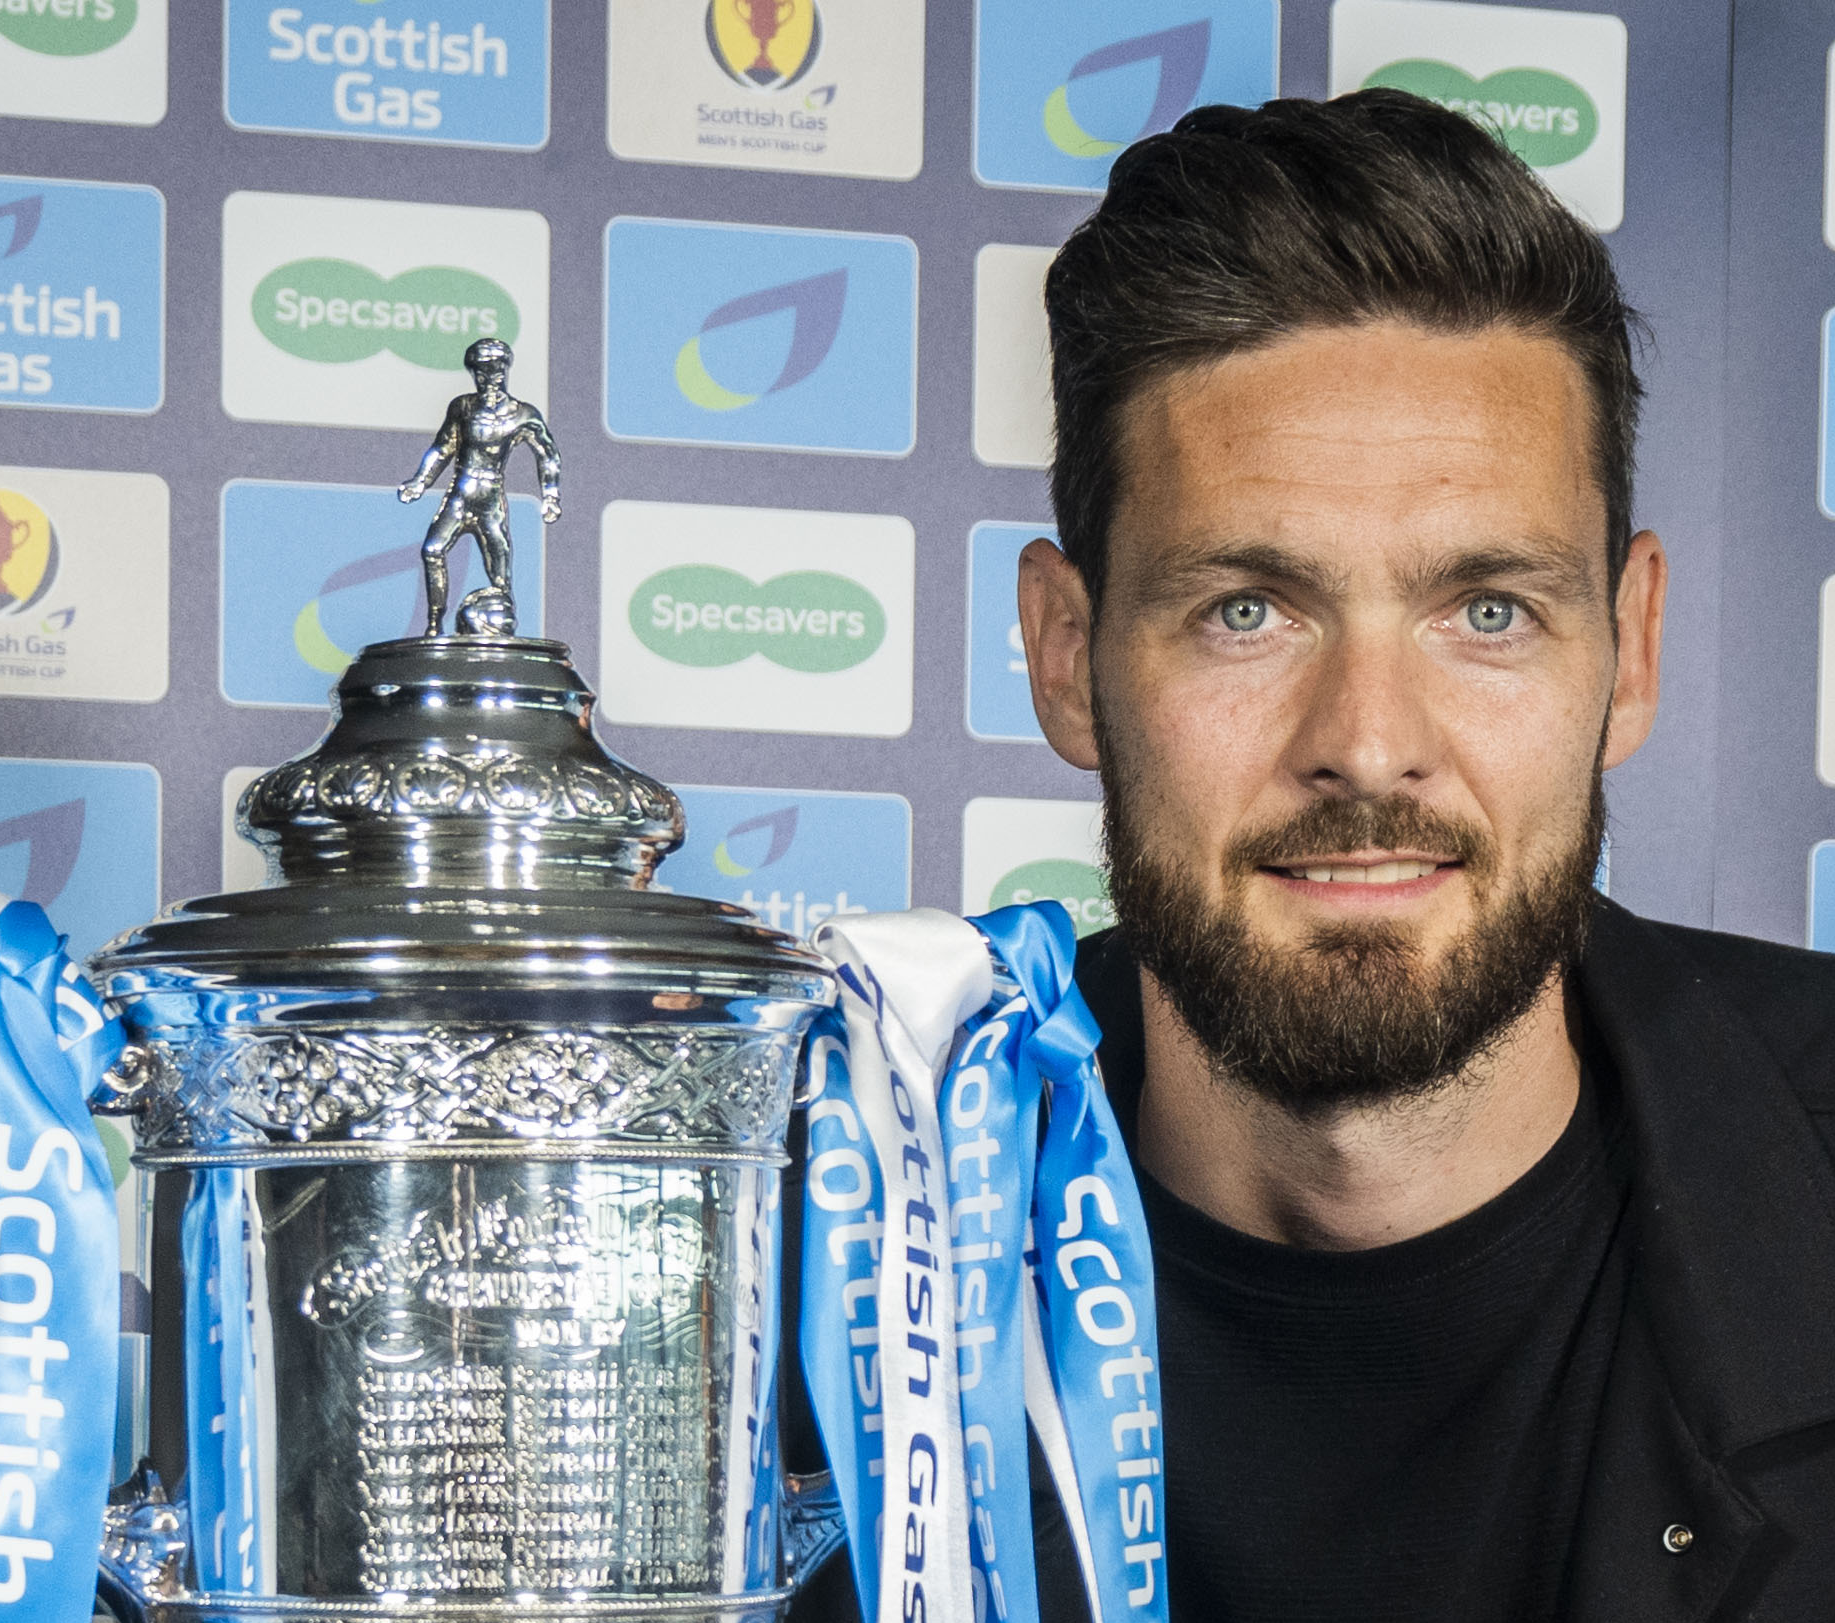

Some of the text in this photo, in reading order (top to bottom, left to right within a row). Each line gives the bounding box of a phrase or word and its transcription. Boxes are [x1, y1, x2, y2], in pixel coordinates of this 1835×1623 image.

[267, 7, 509, 79] Scottish
[332, 69, 444, 132] Gas
[273, 285, 500, 339] Specsavers
[651, 593, 866, 639] Specsavers
[1054, 1174, 1167, 1608] Scottish
[965, 1423, 1008, 1621] Gas
